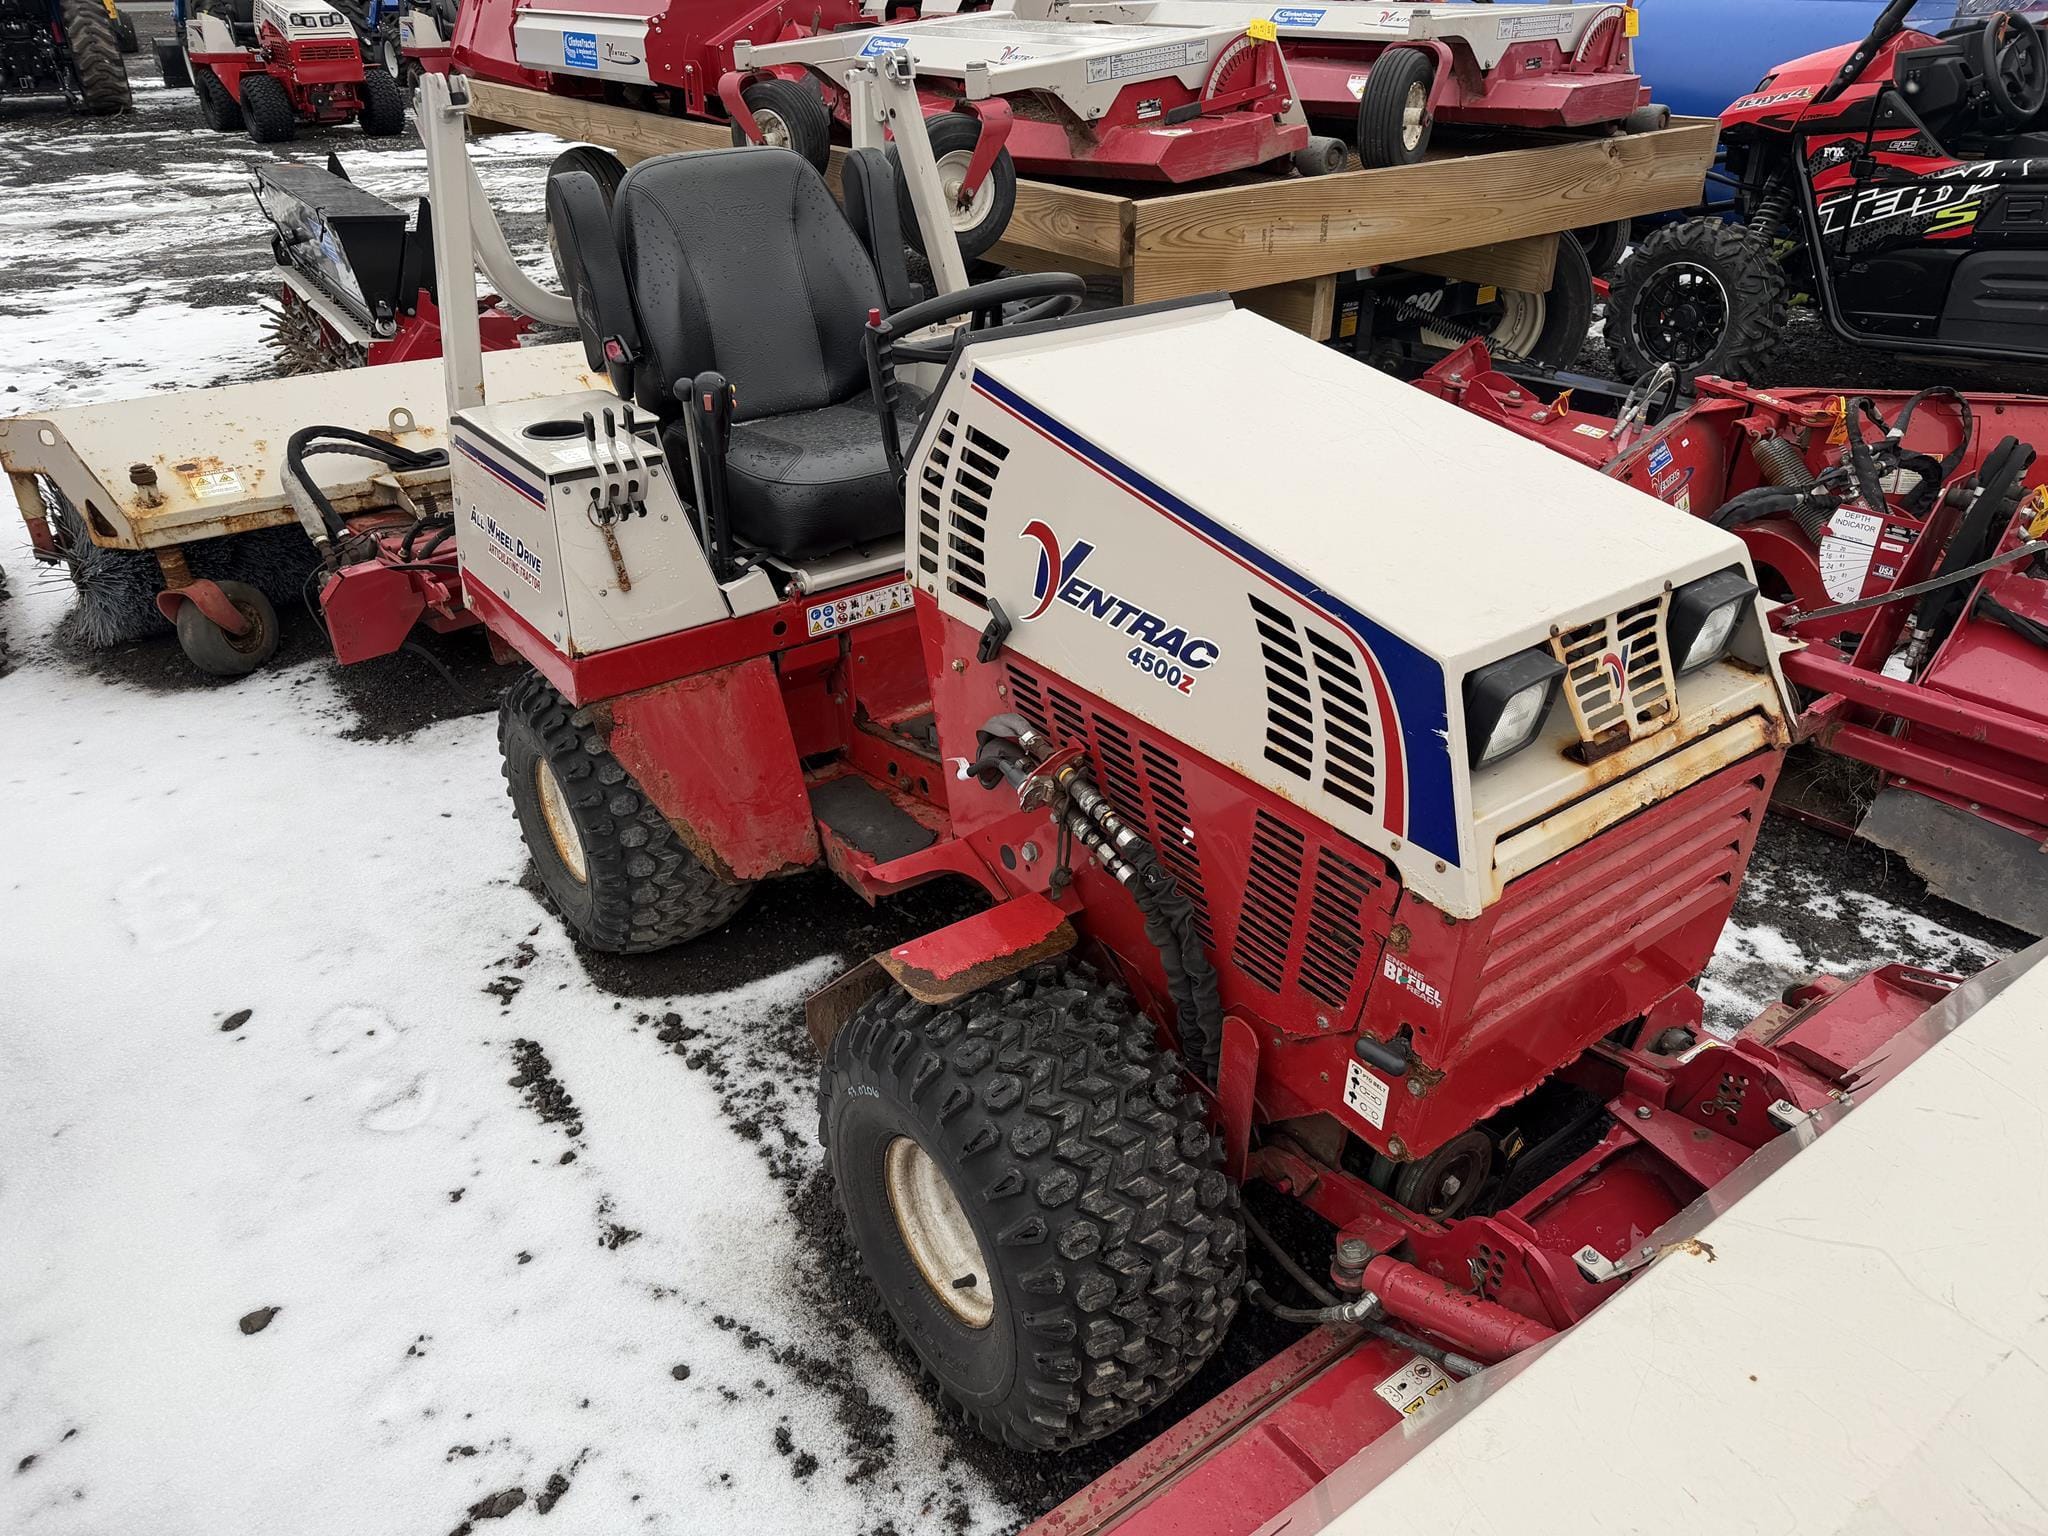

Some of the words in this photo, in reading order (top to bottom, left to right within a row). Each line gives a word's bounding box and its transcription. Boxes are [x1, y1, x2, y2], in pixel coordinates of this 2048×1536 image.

[606, 42, 628, 57] VENTRAC
[1824, 147, 1845, 161] FOX
[1652, 469, 1680, 500] VENTRAC
[1835, 518, 1876, 533] INDICATOR
[1844, 511, 1871, 523] DEPTH
[471, 505, 485, 530] ALL
[487, 516, 514, 553] WHEEL
[516, 538, 541, 573] DRIVE
[1826, 552, 1832, 560] 16
[488, 542, 519, 575] ARTICULATING
[519, 566, 541, 592] TRACTOR
[1826, 562, 1834, 570] 24
[1878, 564, 1894, 577] USA
[1828, 574, 1836, 582] 32
[1020, 520, 1220, 670] VENTRAC
[1128, 647, 1195, 695] 4500Z
[1386, 953, 1425, 981] ENGINE
[1406, 984, 1442, 1009] READY
[1362, 1073, 1373, 1084] PTO
[1372, 1080, 1386, 1093] BELT
